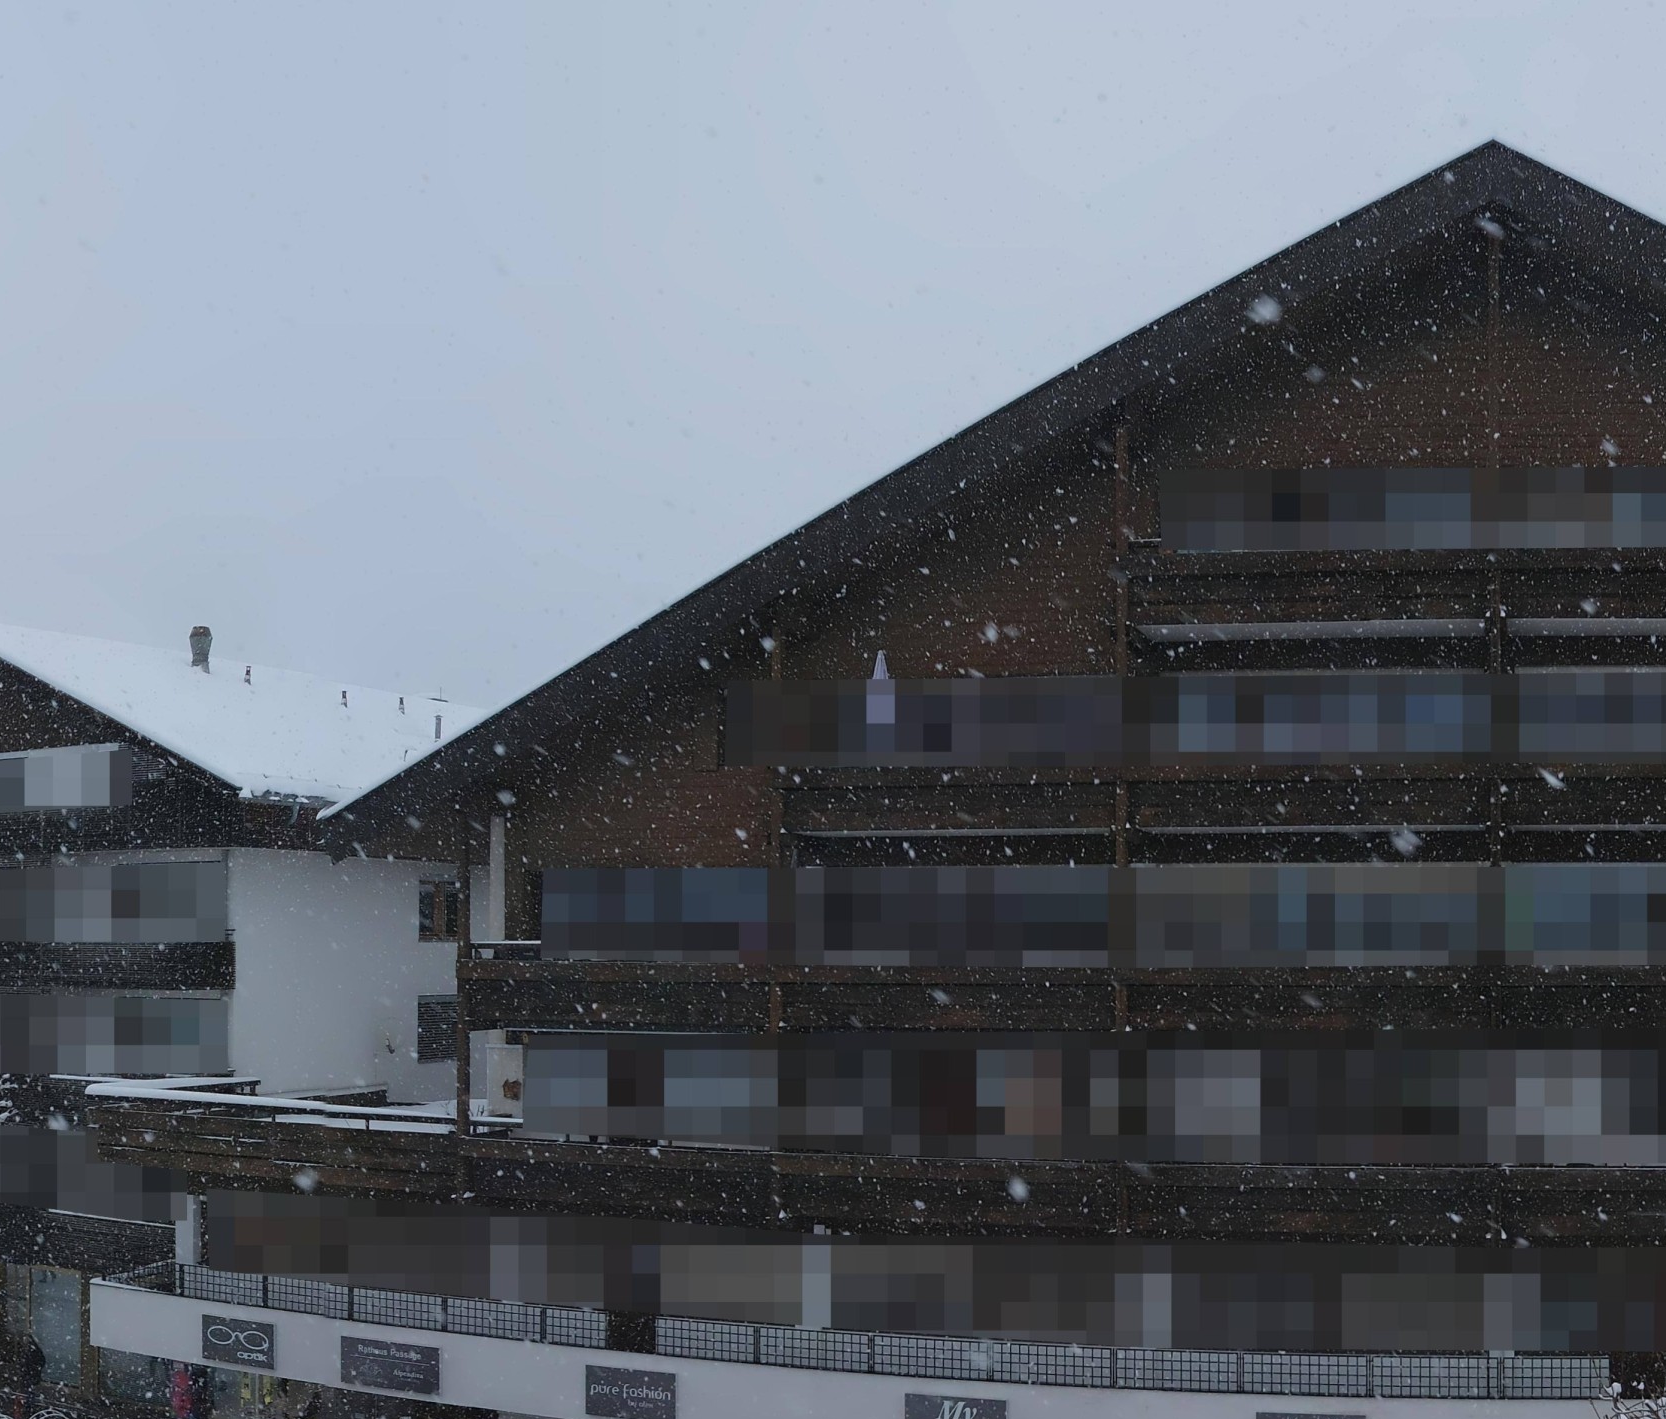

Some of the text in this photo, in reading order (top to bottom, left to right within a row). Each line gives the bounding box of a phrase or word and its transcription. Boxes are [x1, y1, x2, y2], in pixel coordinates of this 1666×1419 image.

[237, 1351, 268, 1362] optik
[590, 1383, 671, 1401] pure fashion
